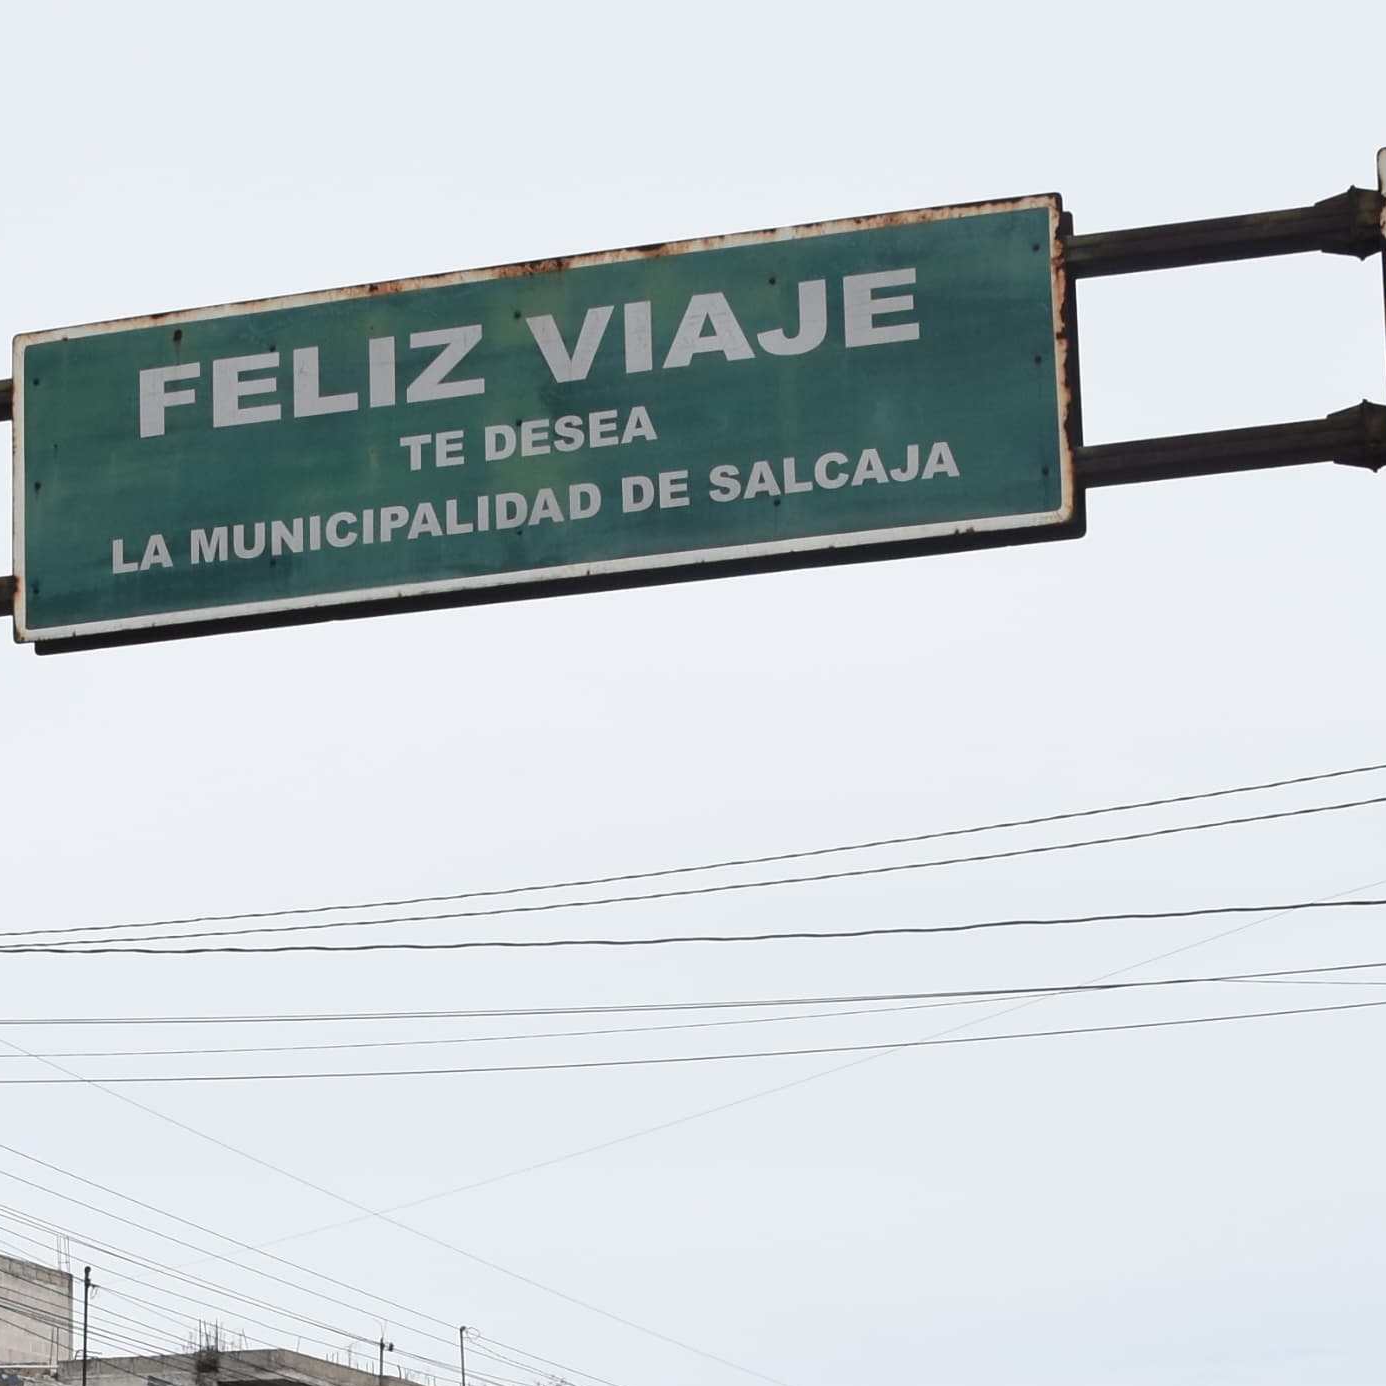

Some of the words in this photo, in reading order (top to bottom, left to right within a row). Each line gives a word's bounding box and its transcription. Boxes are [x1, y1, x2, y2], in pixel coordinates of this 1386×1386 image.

[139, 324, 485, 438] FELIZ
[525, 267, 920, 383] VIAJE
[399, 430, 465, 471] TE
[484, 406, 657, 461] DESEA
[112, 534, 173, 574] LA
[190, 483, 601, 564] MUNICIPALIDAD
[621, 470, 690, 513] DE
[709, 441, 960, 502] SALCAJA
